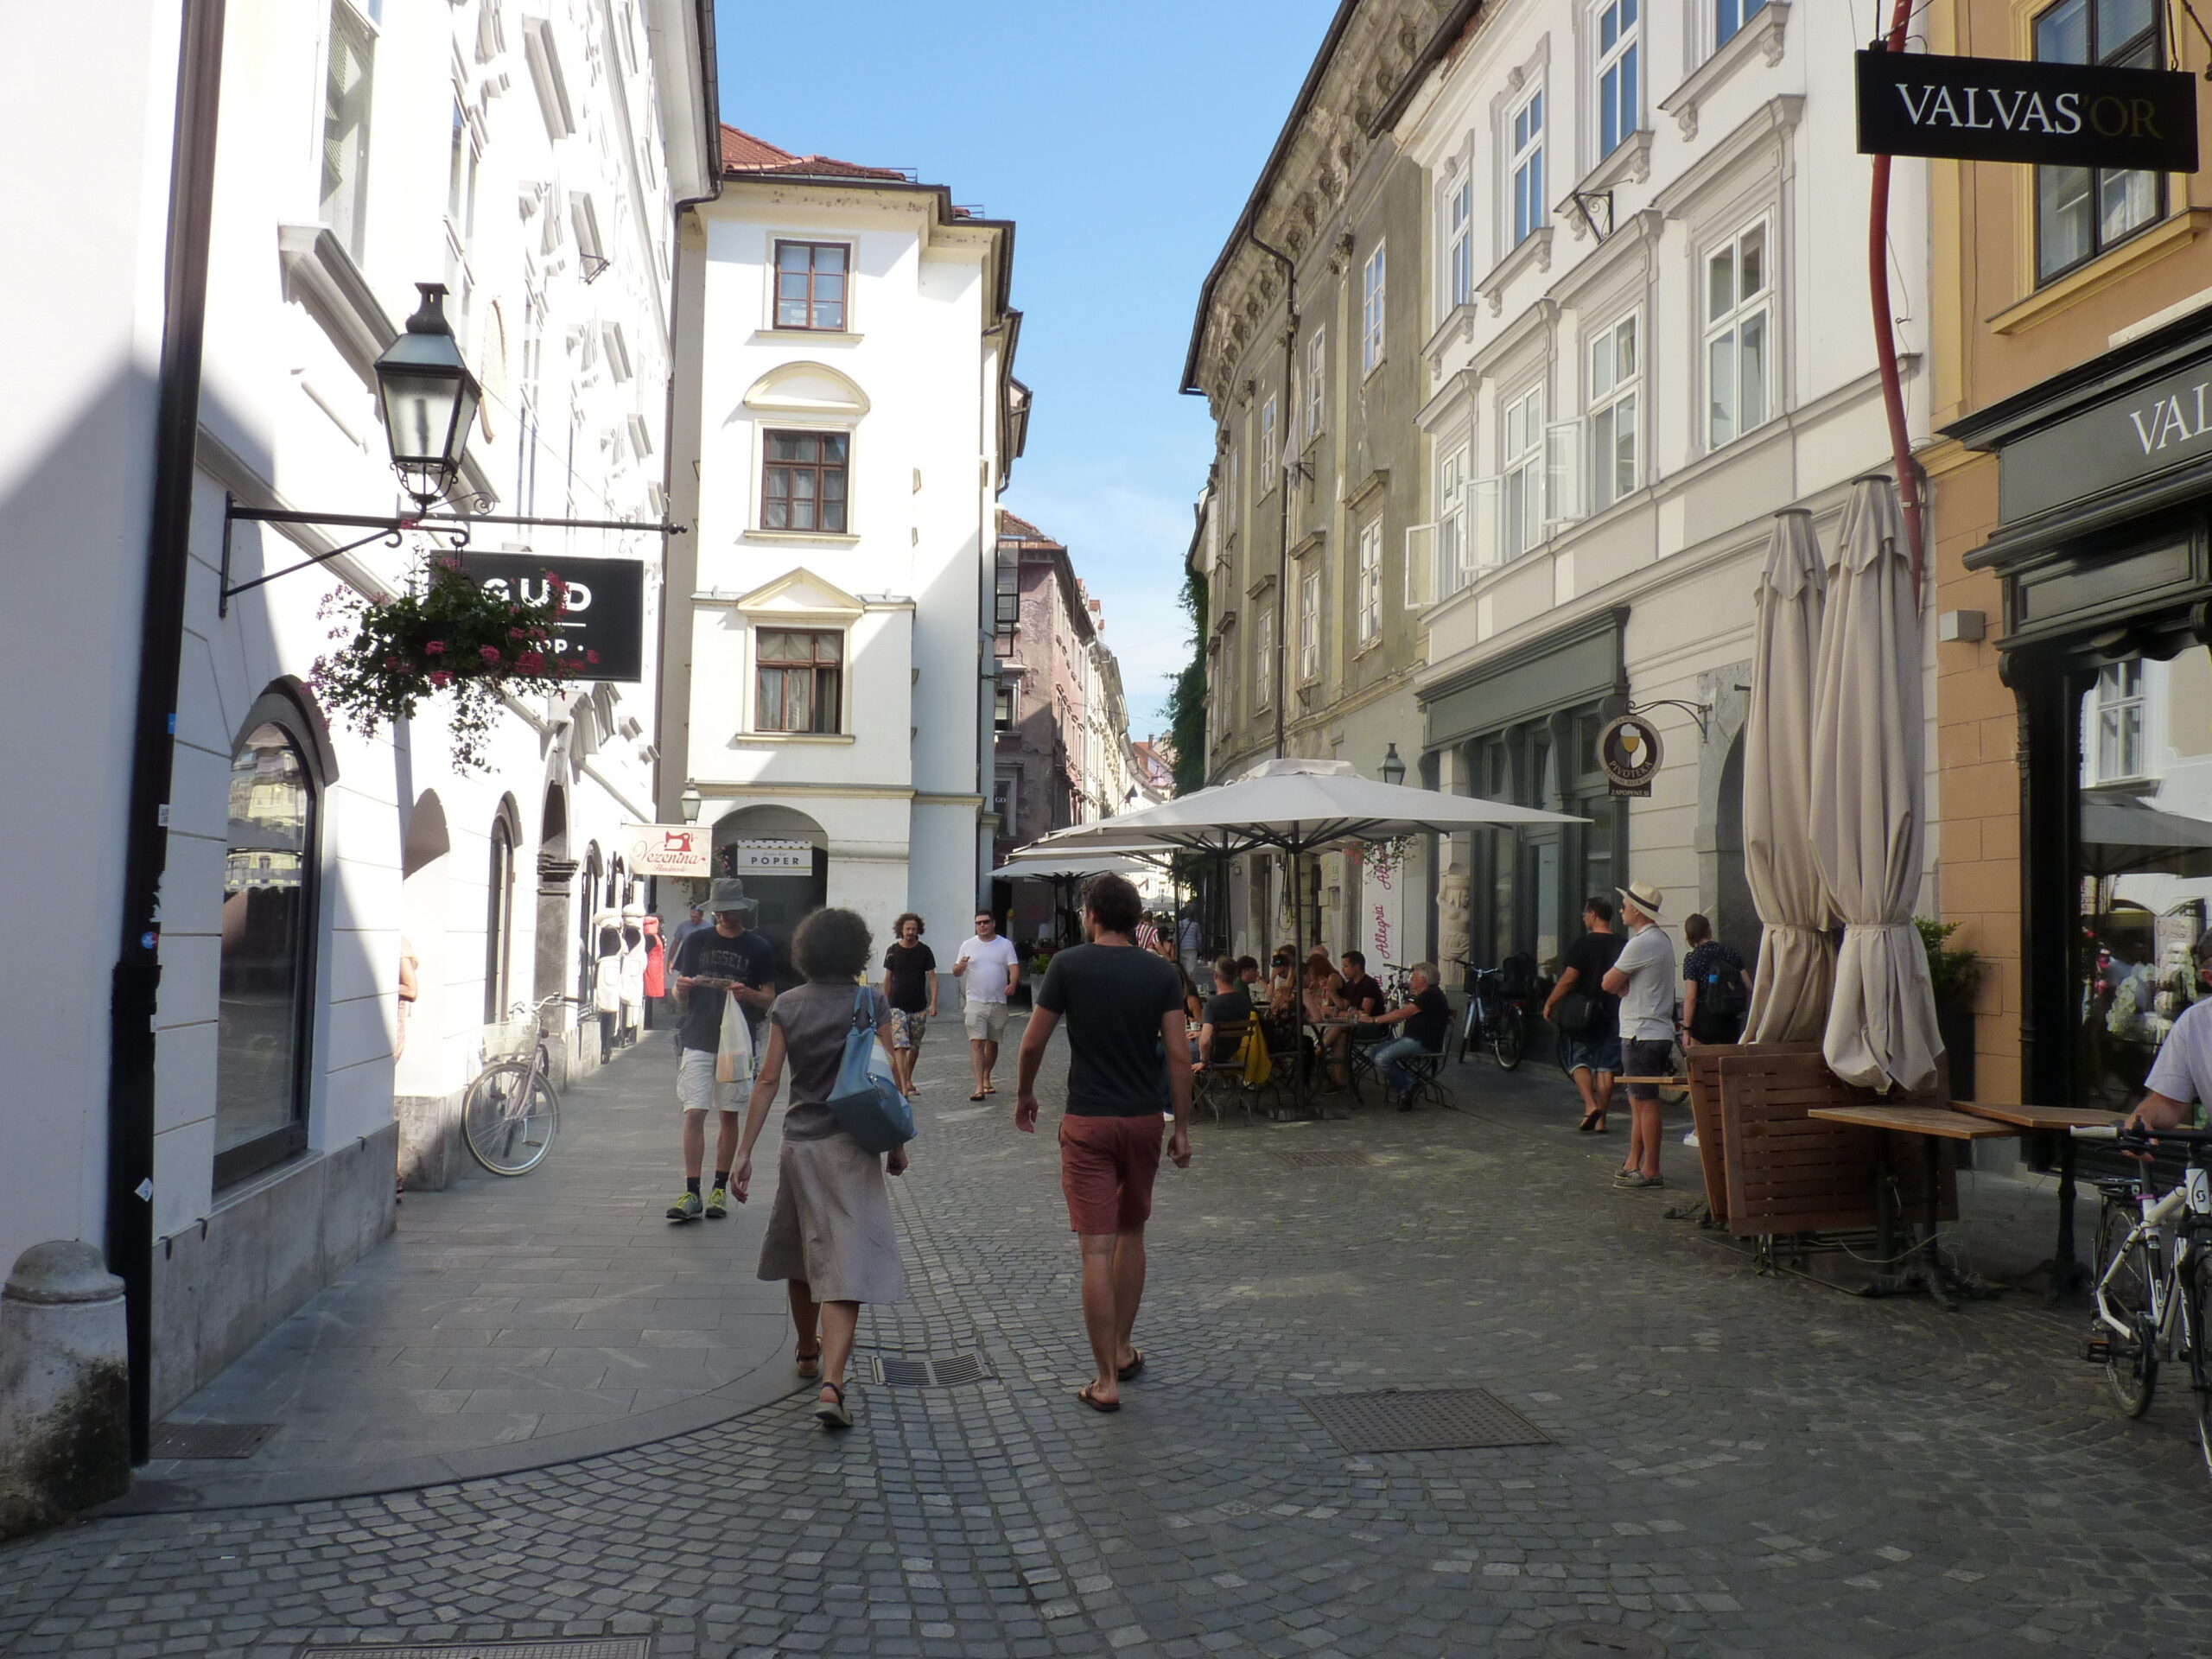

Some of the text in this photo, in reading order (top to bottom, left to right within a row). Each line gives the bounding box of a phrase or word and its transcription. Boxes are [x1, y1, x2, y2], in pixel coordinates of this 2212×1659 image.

[1609, 760, 1653, 779] PIVOTEKA
[632, 840, 706, 865] Vezenina
[751, 856, 799, 866] POPER
[1374, 905, 1391, 959] Allegria
